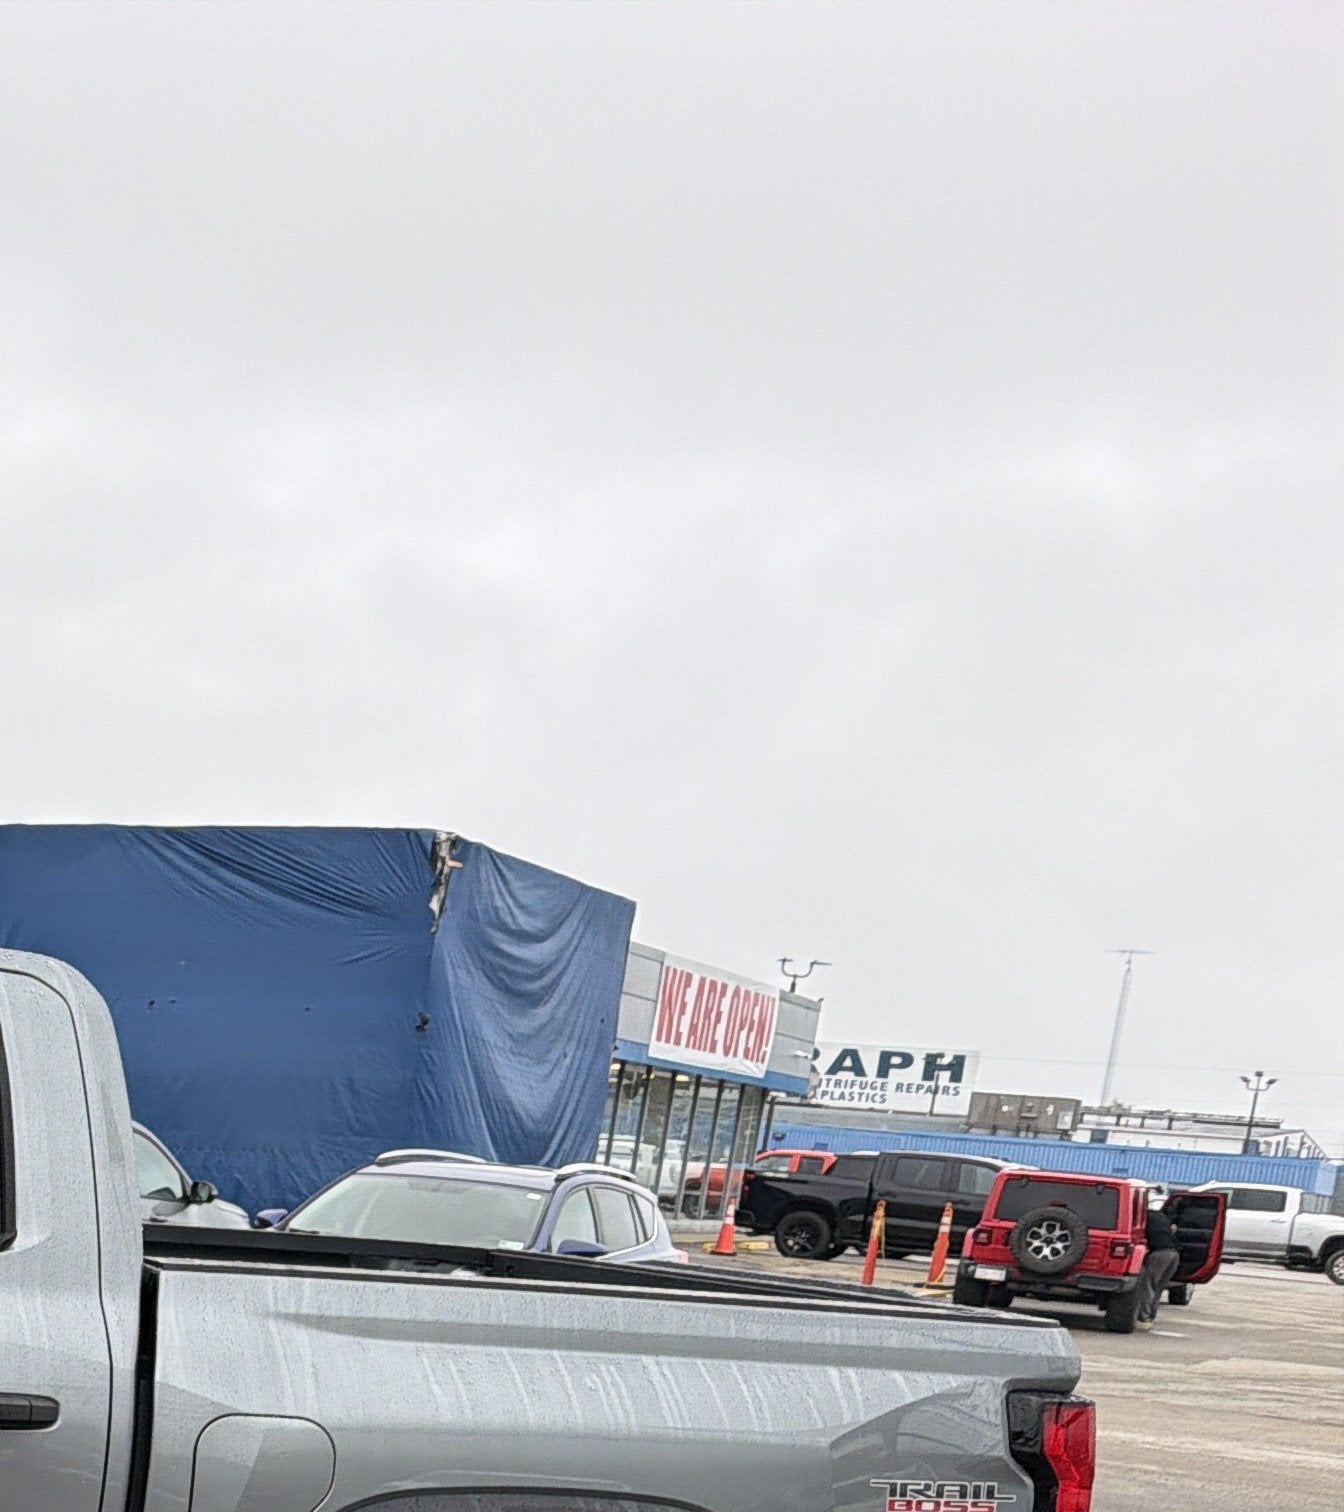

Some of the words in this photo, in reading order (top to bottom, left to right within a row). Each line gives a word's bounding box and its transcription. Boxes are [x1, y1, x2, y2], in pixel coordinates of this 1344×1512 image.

[655, 965, 693, 1046] WE
[685, 976, 728, 1054] ARE
[722, 985, 776, 1064] OPEN!
[820, 1090, 887, 1104] PLASTICS
[870, 1479, 1016, 1503] TRAIL
